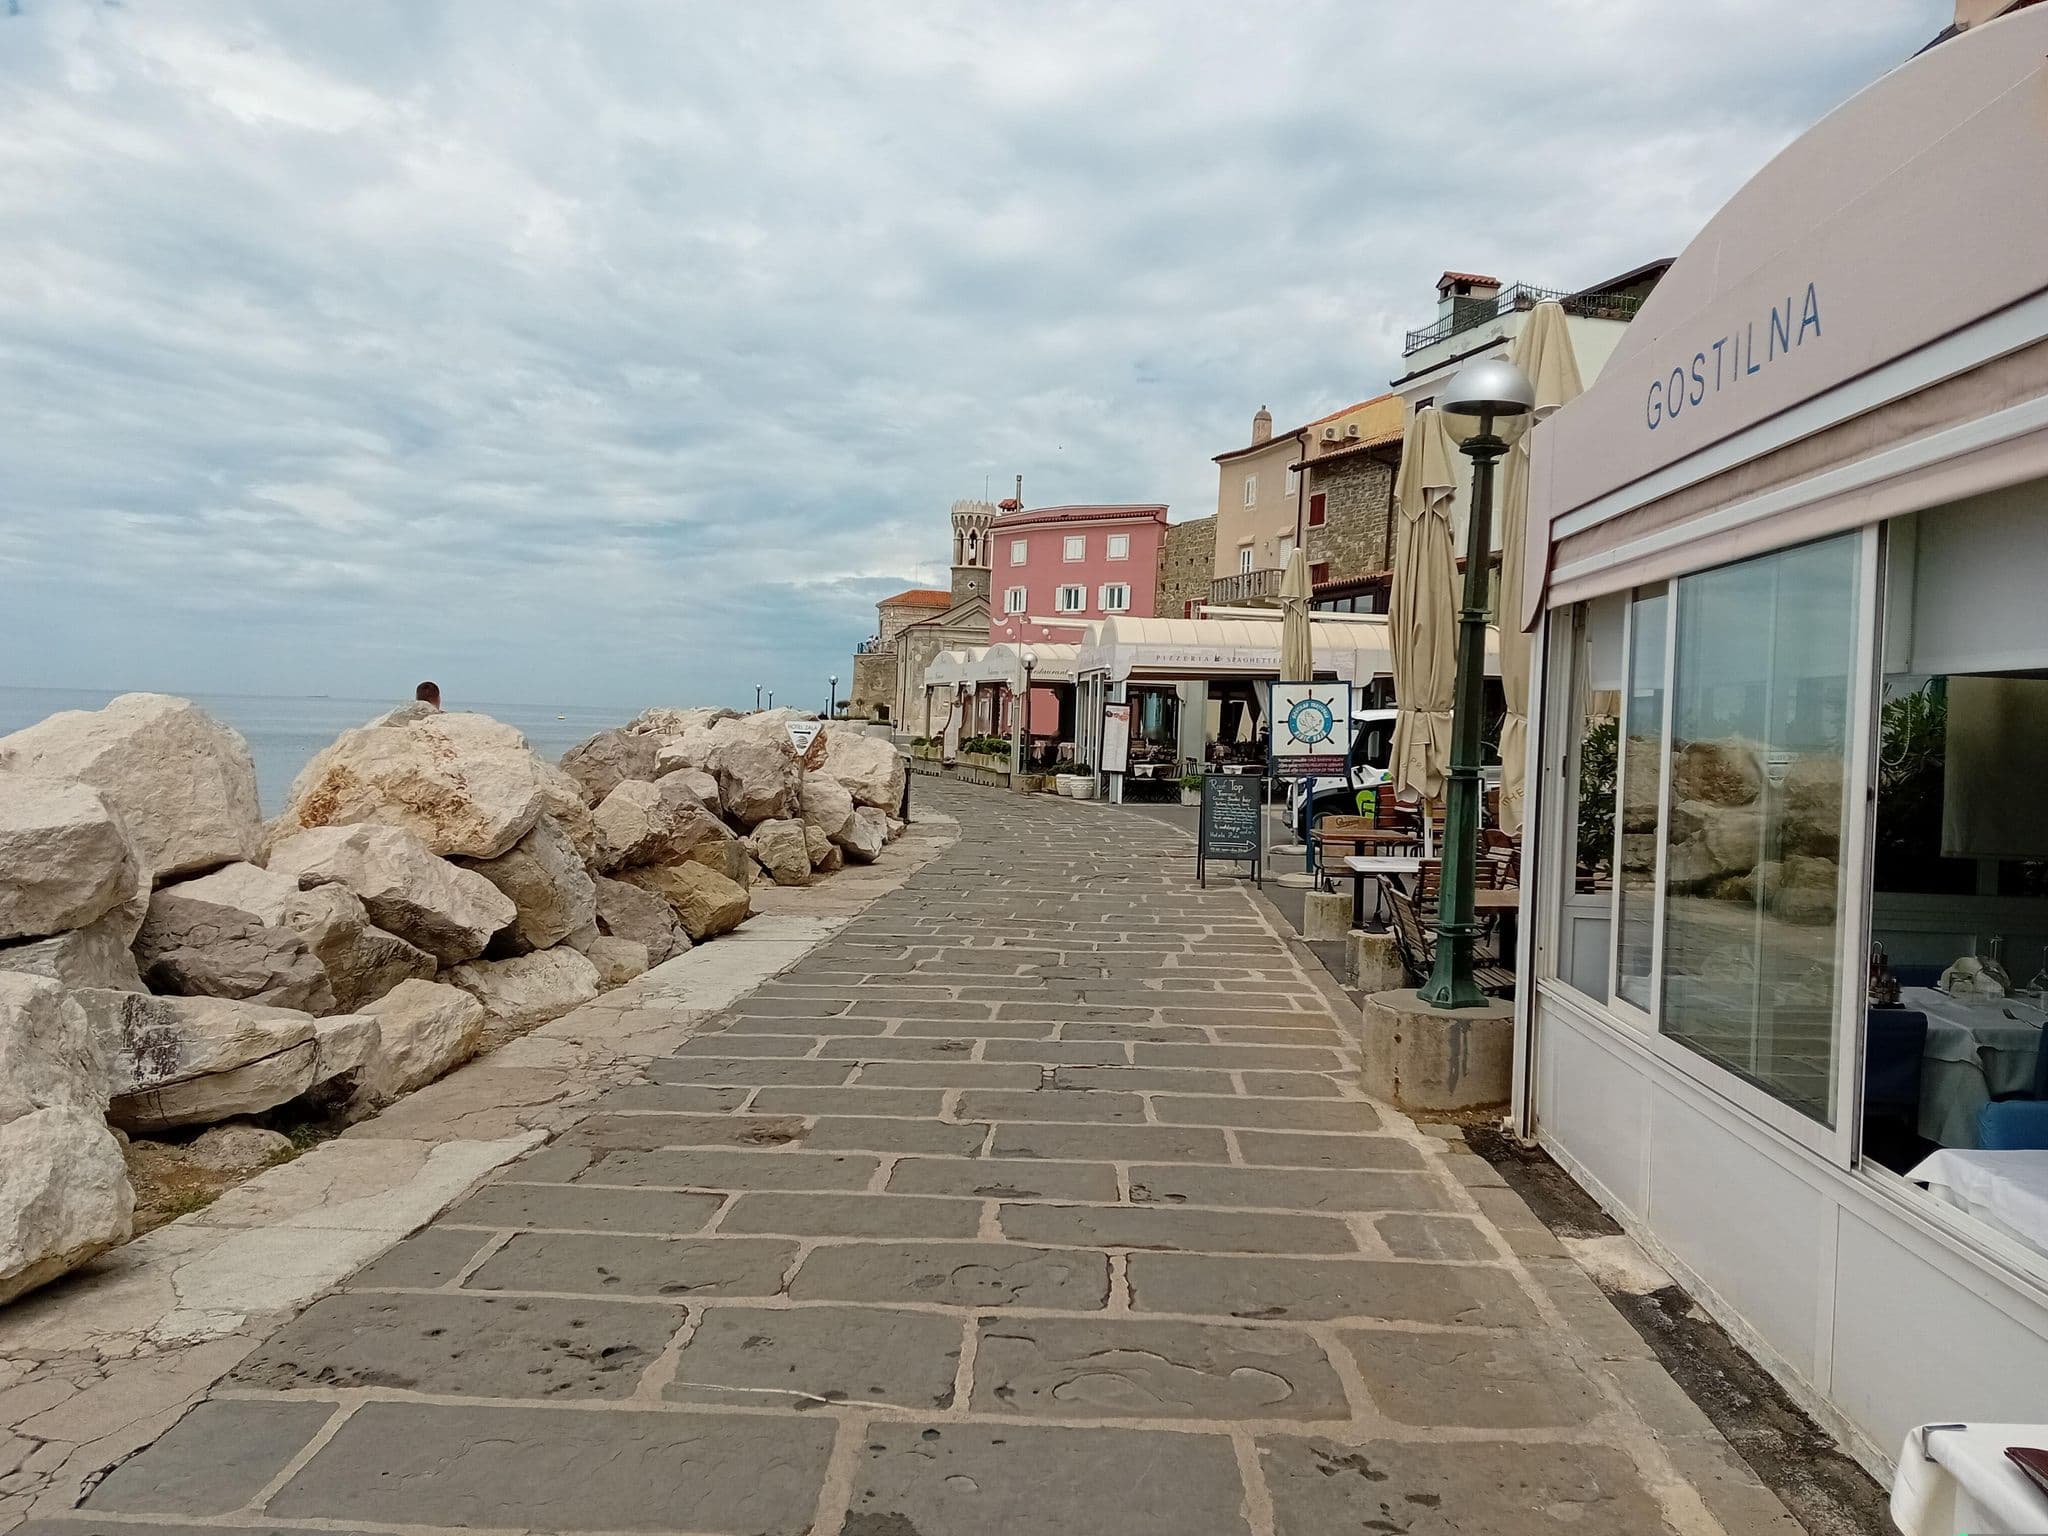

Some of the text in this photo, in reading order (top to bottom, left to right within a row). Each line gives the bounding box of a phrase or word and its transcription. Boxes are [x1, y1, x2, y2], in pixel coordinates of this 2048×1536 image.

[1647, 282, 1821, 429] GOSTILNA
[1032, 667, 1069, 676] estaurant
[1228, 779, 1244, 793] Top
